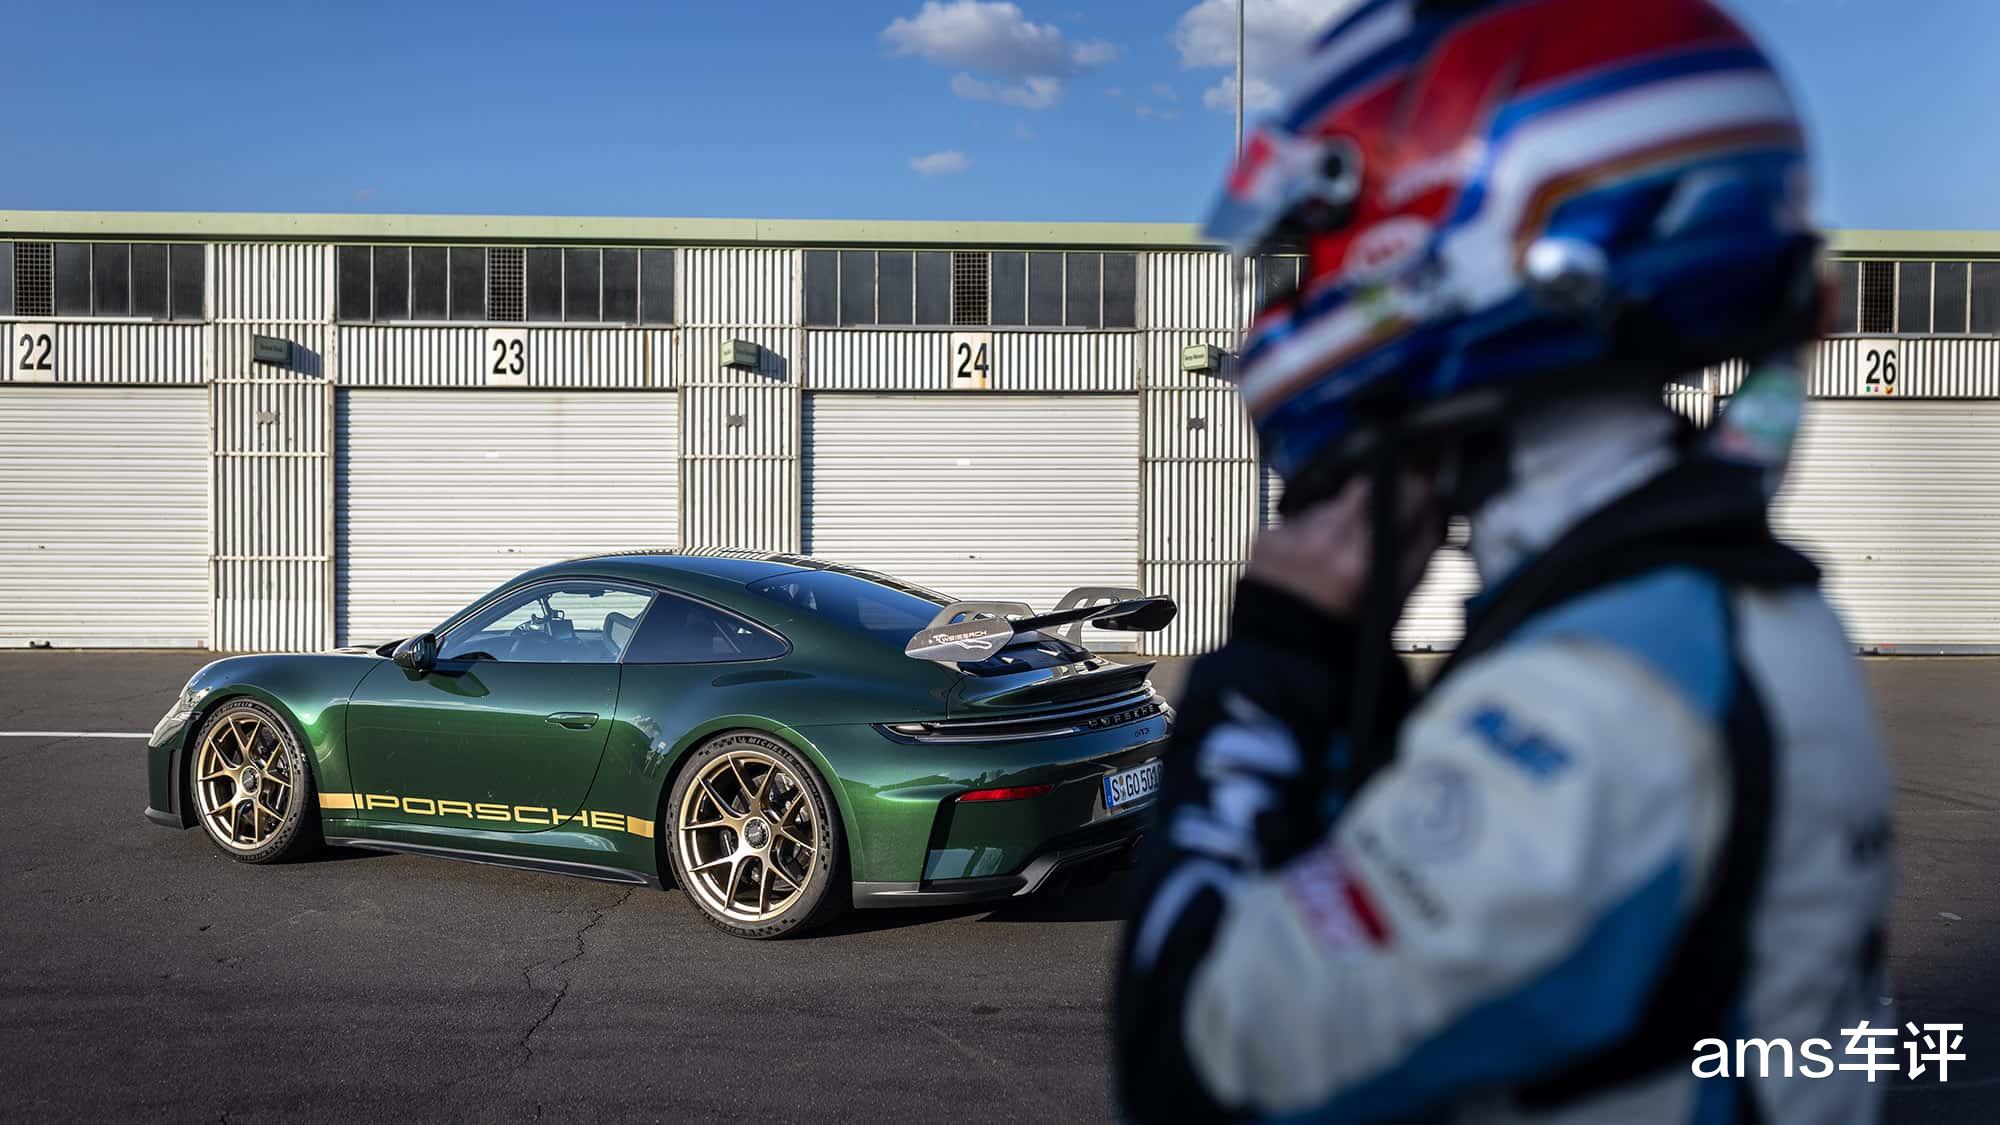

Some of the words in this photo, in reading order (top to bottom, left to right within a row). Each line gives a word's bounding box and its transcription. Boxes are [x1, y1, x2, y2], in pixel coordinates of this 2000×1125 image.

[19, 333, 52, 370] 22
[492, 338, 525, 376] 23
[956, 341, 990, 379] 24
[1865, 349, 1897, 385] 26
[748, 736, 795, 763] MICHELIN
[1111, 778, 1121, 802] S
[366, 793, 626, 832] PORSCHE
